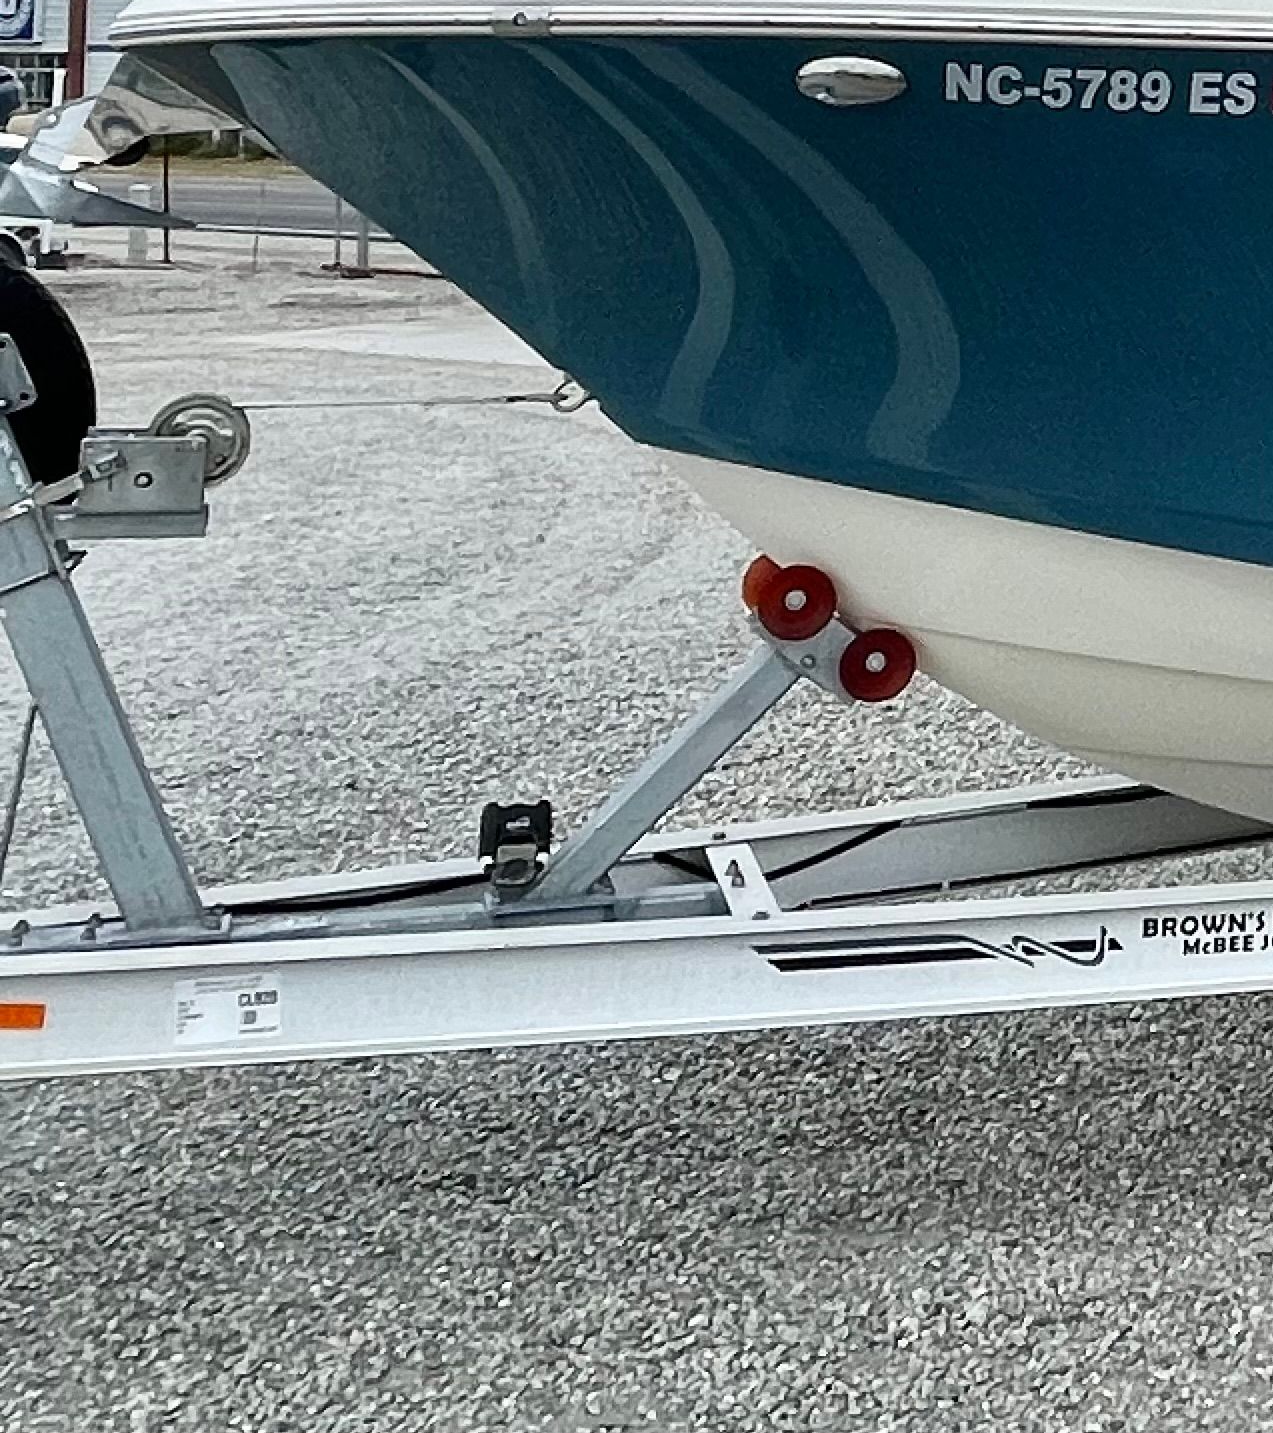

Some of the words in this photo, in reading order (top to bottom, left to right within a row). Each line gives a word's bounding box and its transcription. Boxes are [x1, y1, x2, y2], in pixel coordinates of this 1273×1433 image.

[944, 61, 1171, 113] NC-5789
[1188, 71, 1257, 116] ES
[1142, 910, 1265, 938] BROWN'S
